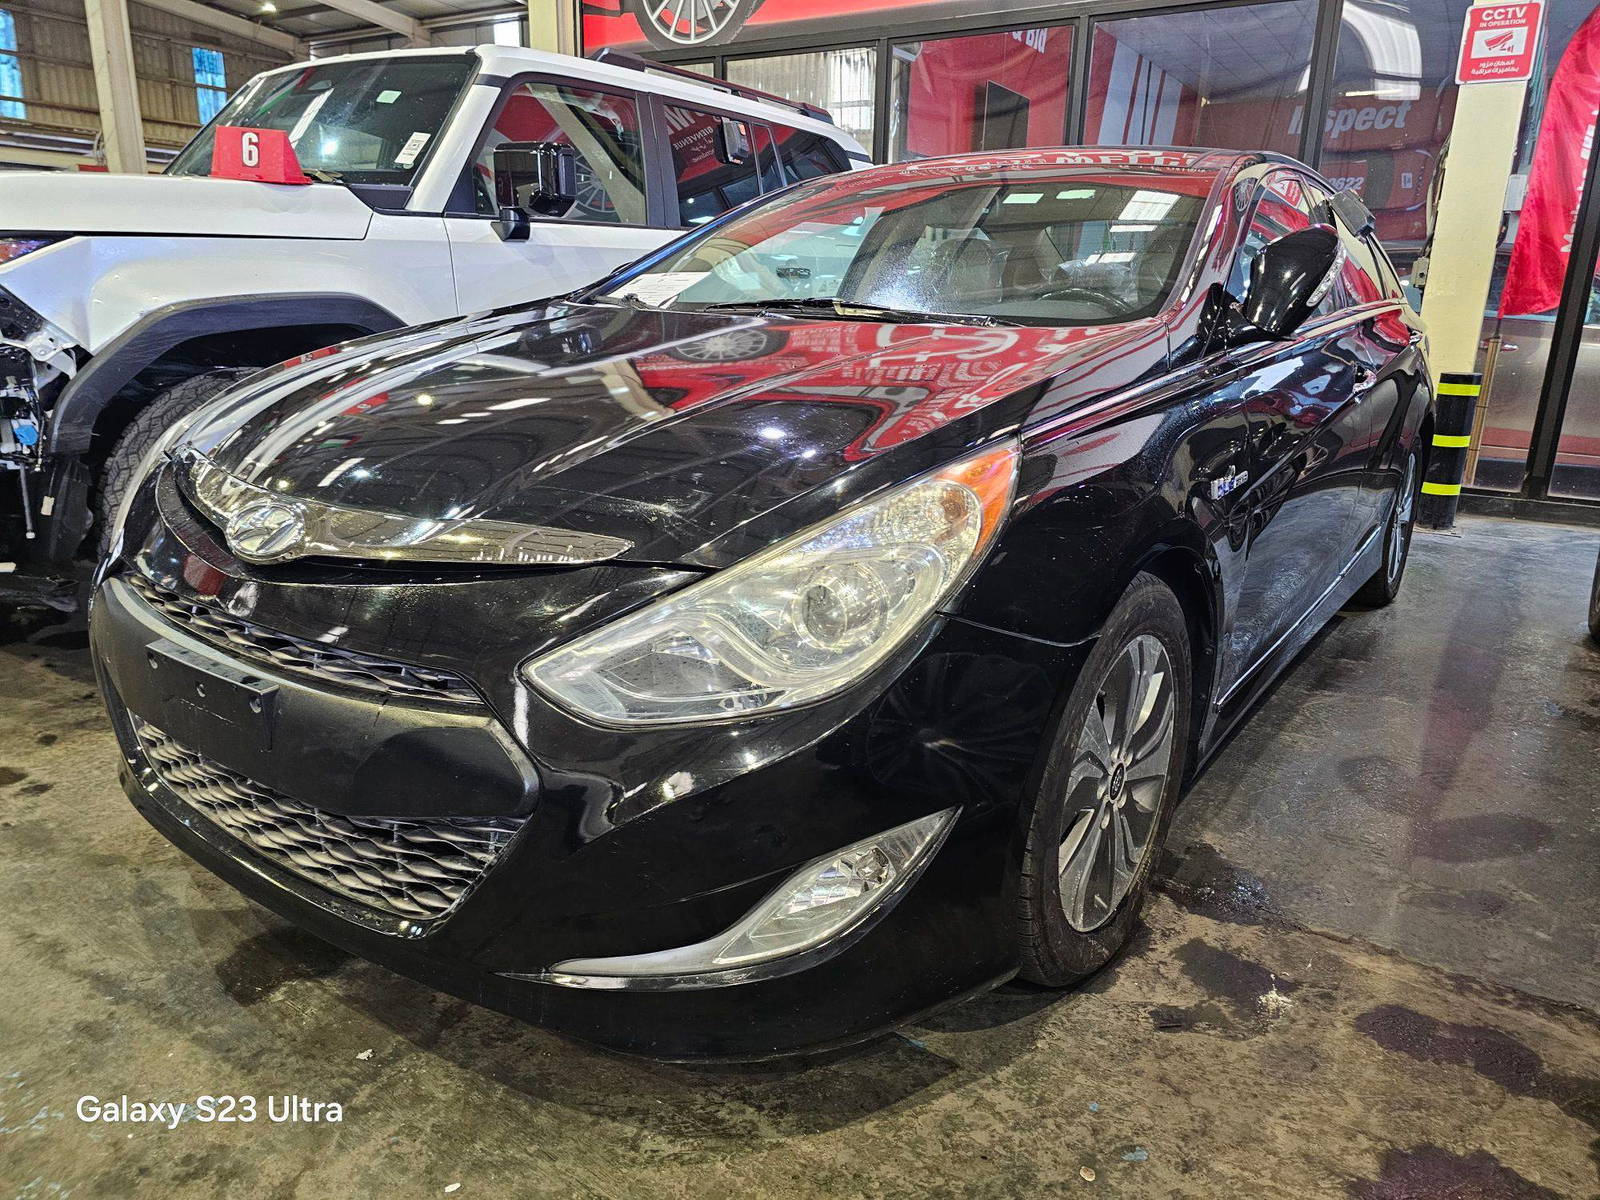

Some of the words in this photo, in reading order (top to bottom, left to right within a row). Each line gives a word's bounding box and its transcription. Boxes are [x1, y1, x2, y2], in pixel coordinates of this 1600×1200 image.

[1482, 7, 1527, 20] CCTV
[1488, 18, 1526, 27] OPERATION
[1288, 101, 1411, 138] Ispect
[242, 132, 259, 167] 6
